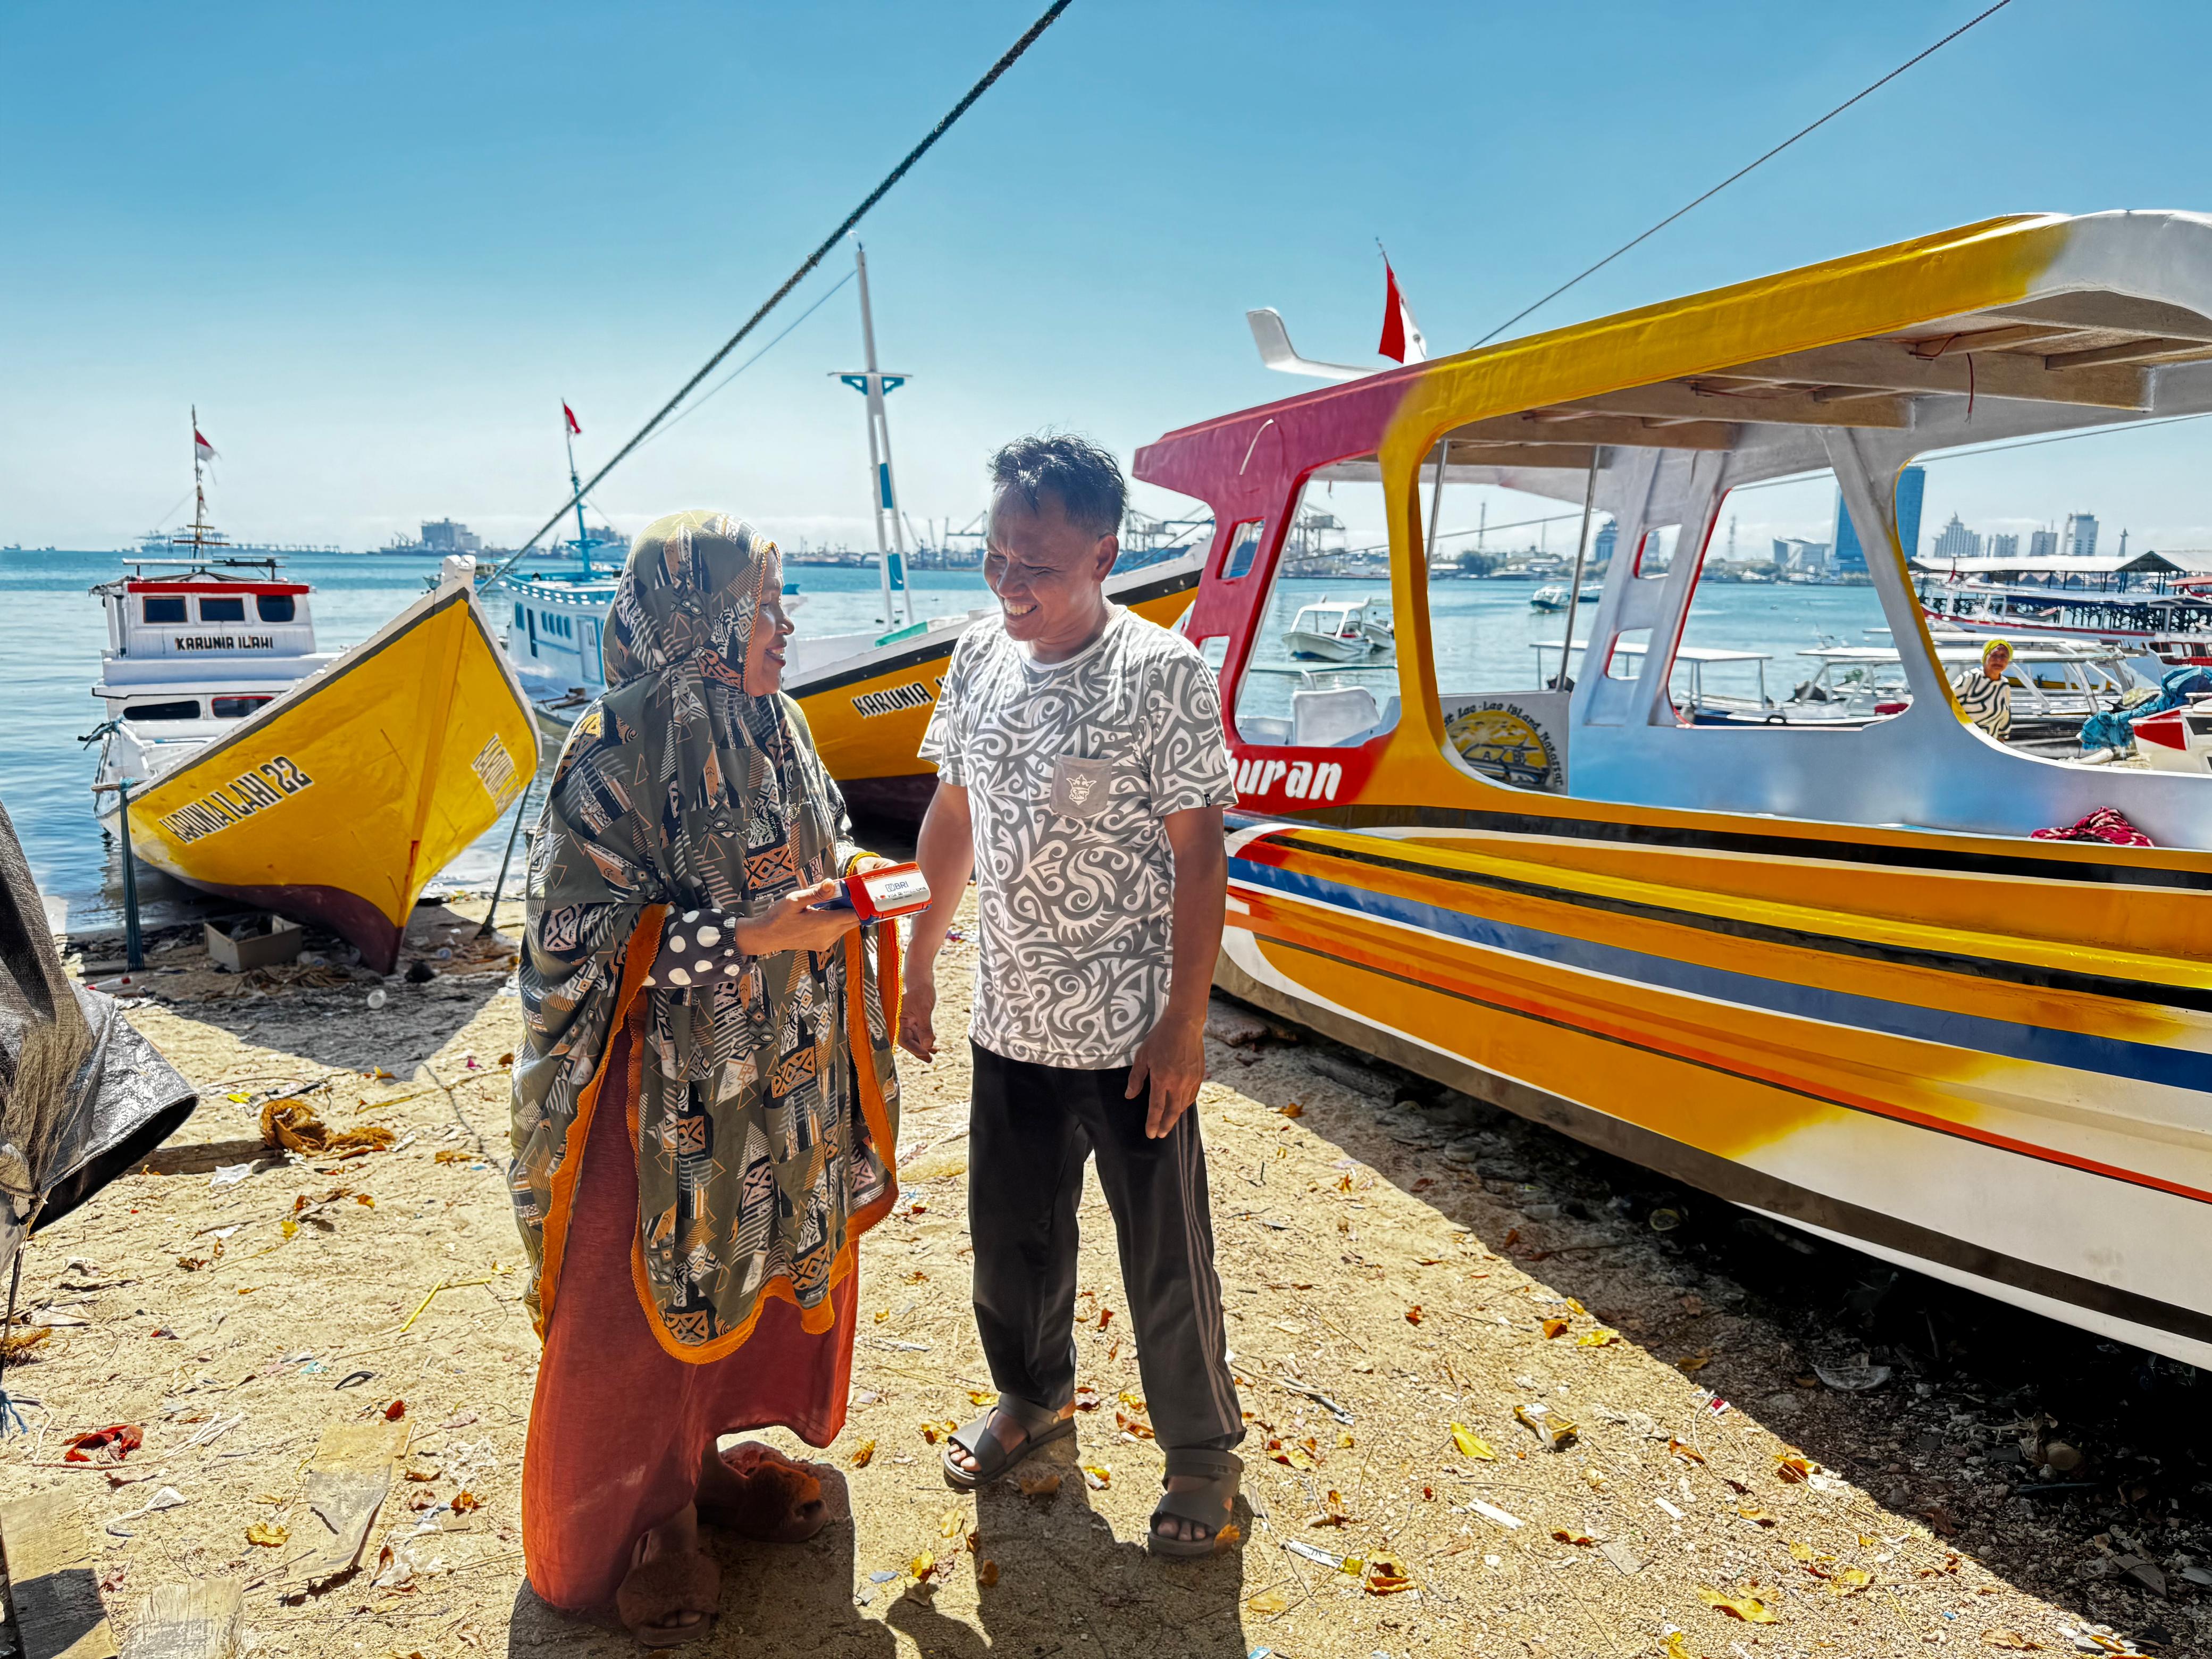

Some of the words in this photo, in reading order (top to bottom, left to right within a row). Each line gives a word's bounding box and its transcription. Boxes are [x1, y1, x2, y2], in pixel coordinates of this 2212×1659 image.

[175, 636, 234, 651] KARUNIA
[851, 682, 934, 717] KARUNIA
[259, 756, 313, 794] 22
[894, 881, 909, 890] BRI
